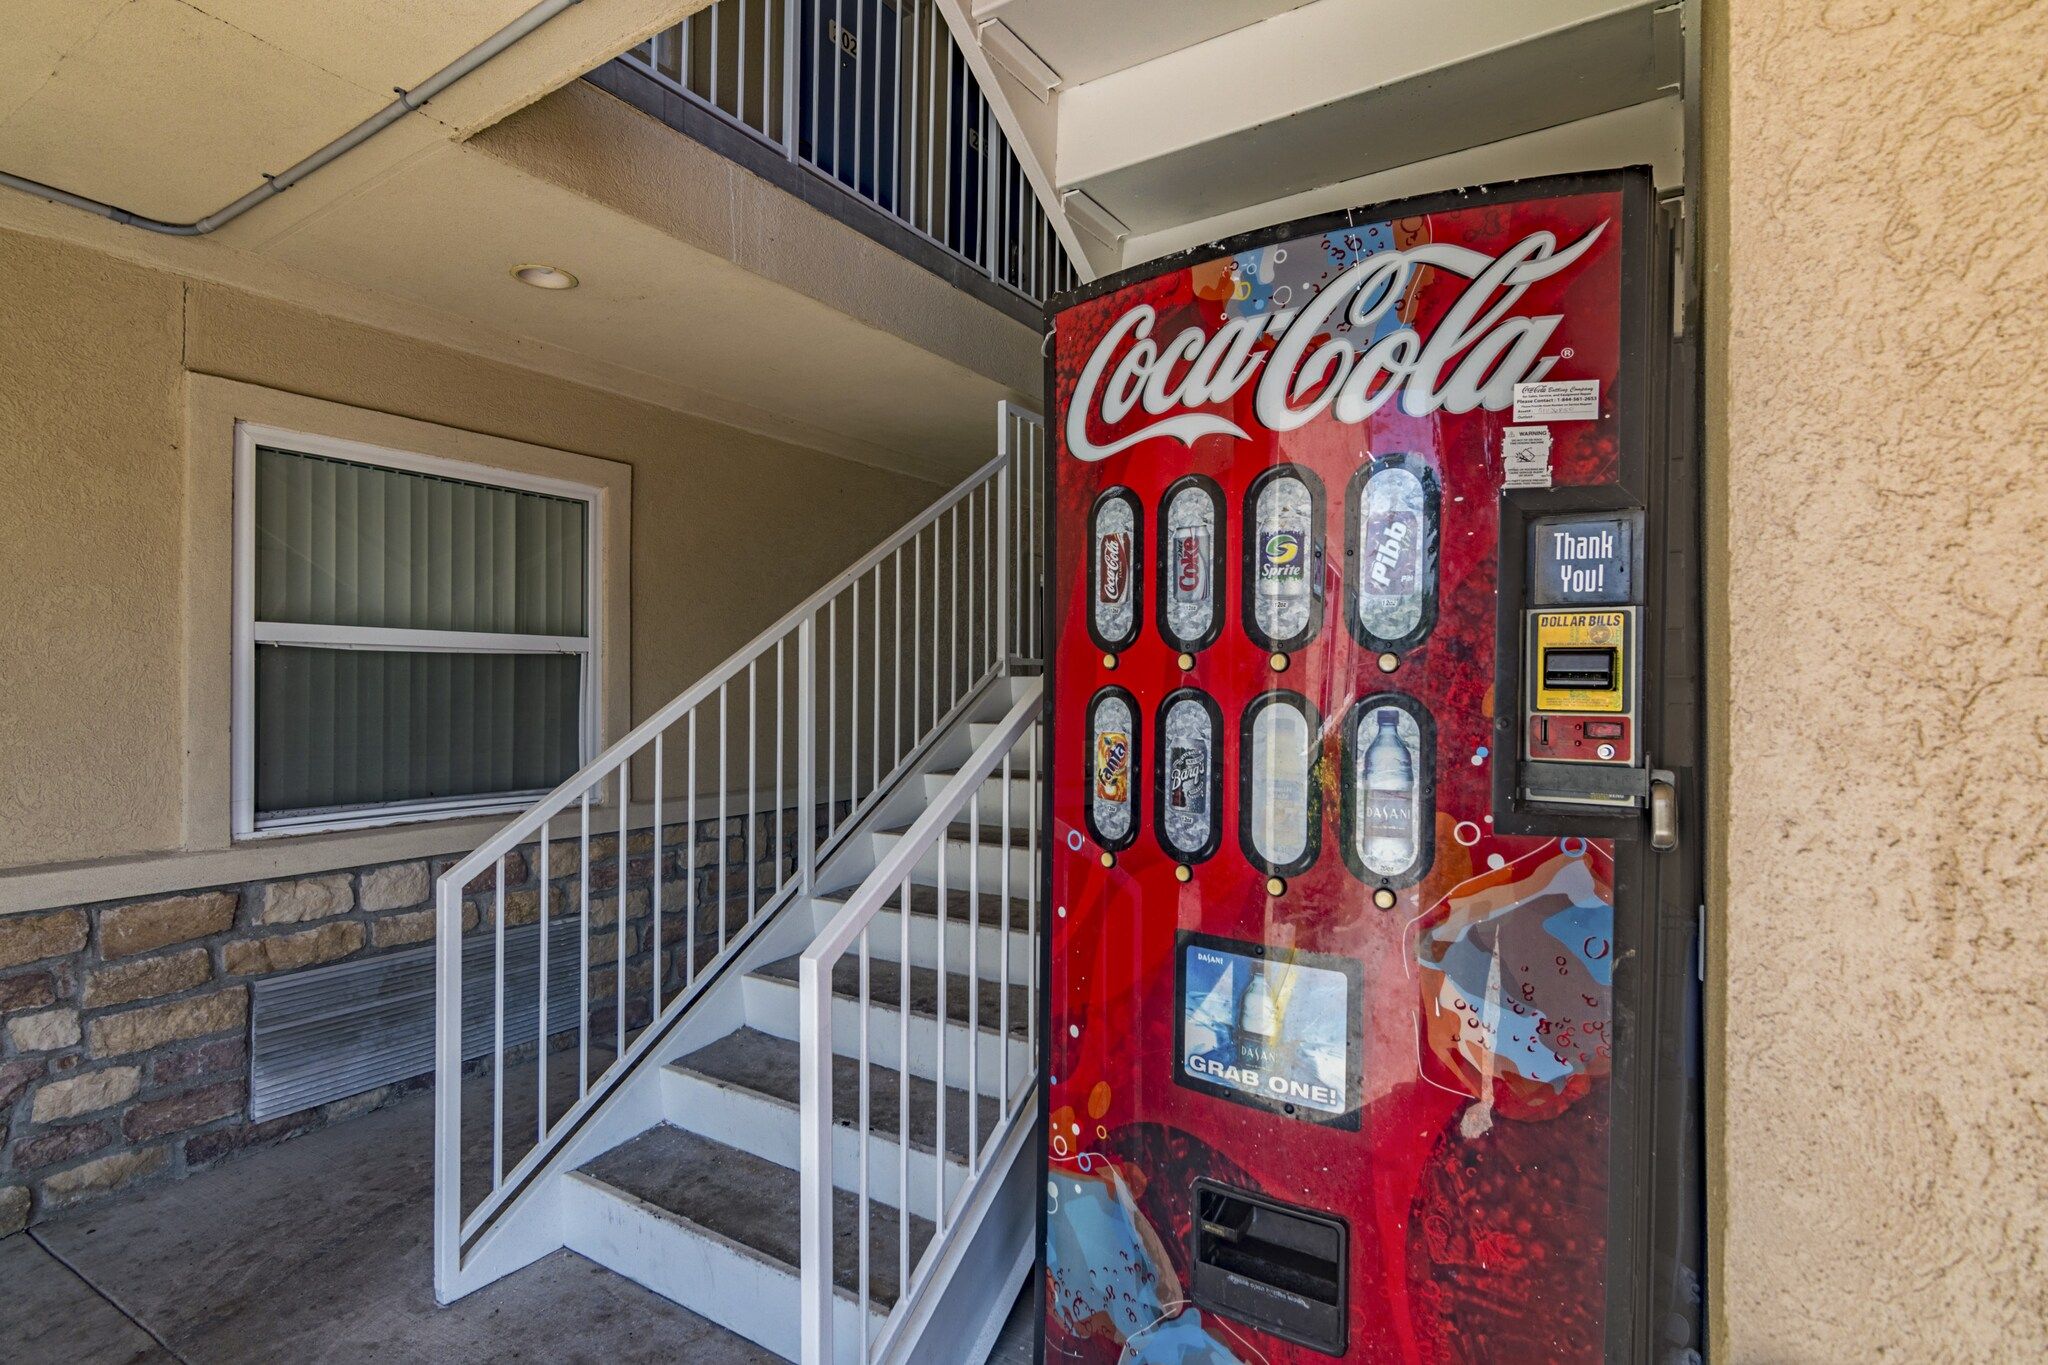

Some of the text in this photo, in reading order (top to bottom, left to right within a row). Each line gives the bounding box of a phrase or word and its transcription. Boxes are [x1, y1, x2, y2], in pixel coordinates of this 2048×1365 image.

[1371, 521, 1408, 587] Pibb
[1554, 530, 1614, 560] Thank
[1178, 536, 1200, 592] Coke
[1262, 563, 1300, 578] Sprite
[1560, 564, 1604, 593] You!
[1541, 614, 1620, 628] DOLLAR BILLS
[1098, 743, 1126, 786] Fanta
[1171, 762, 1204, 791] Barq's
[1366, 806, 1411, 821] DASANI
[1198, 952, 1224, 966] DASANI
[1189, 1055, 1337, 1106] GRAB ONE!
